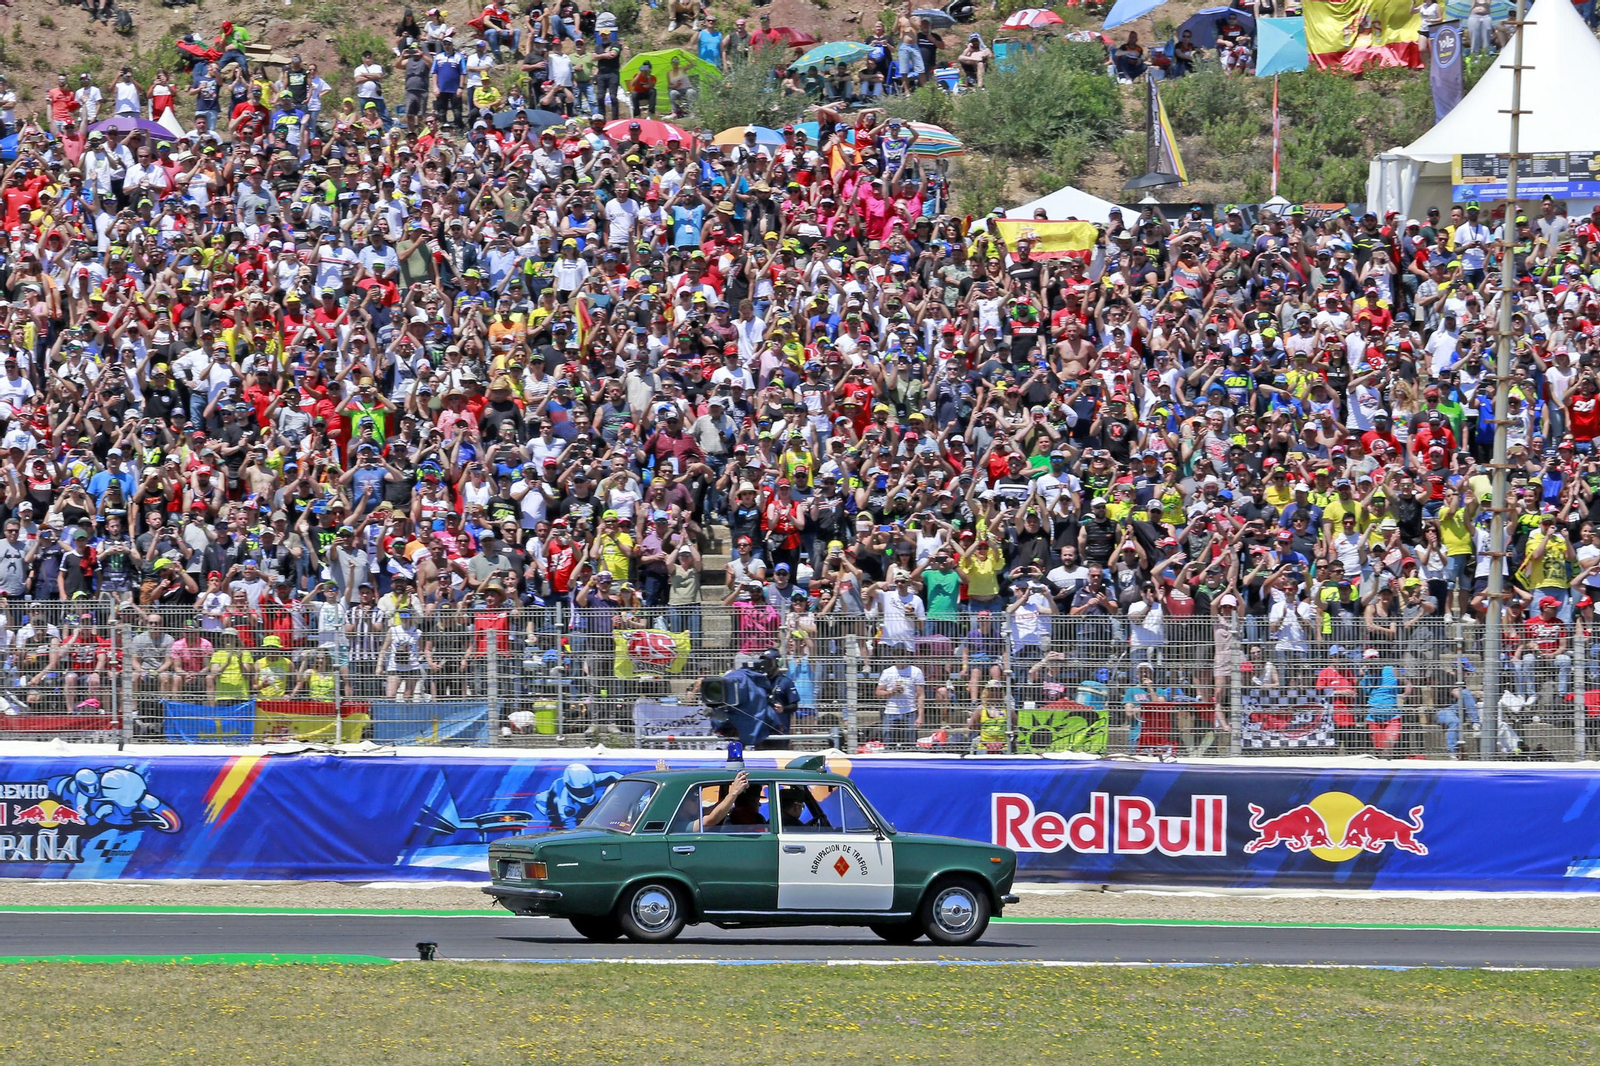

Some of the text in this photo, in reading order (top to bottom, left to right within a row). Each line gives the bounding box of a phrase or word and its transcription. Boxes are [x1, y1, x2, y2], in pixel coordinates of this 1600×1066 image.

[276, 115, 299, 125] 46
[1224, 376, 1248, 387] 46
[993, 793, 1225, 855] Red Bull
[810, 844, 868, 876] AGRUPACION DE TRAFICO
